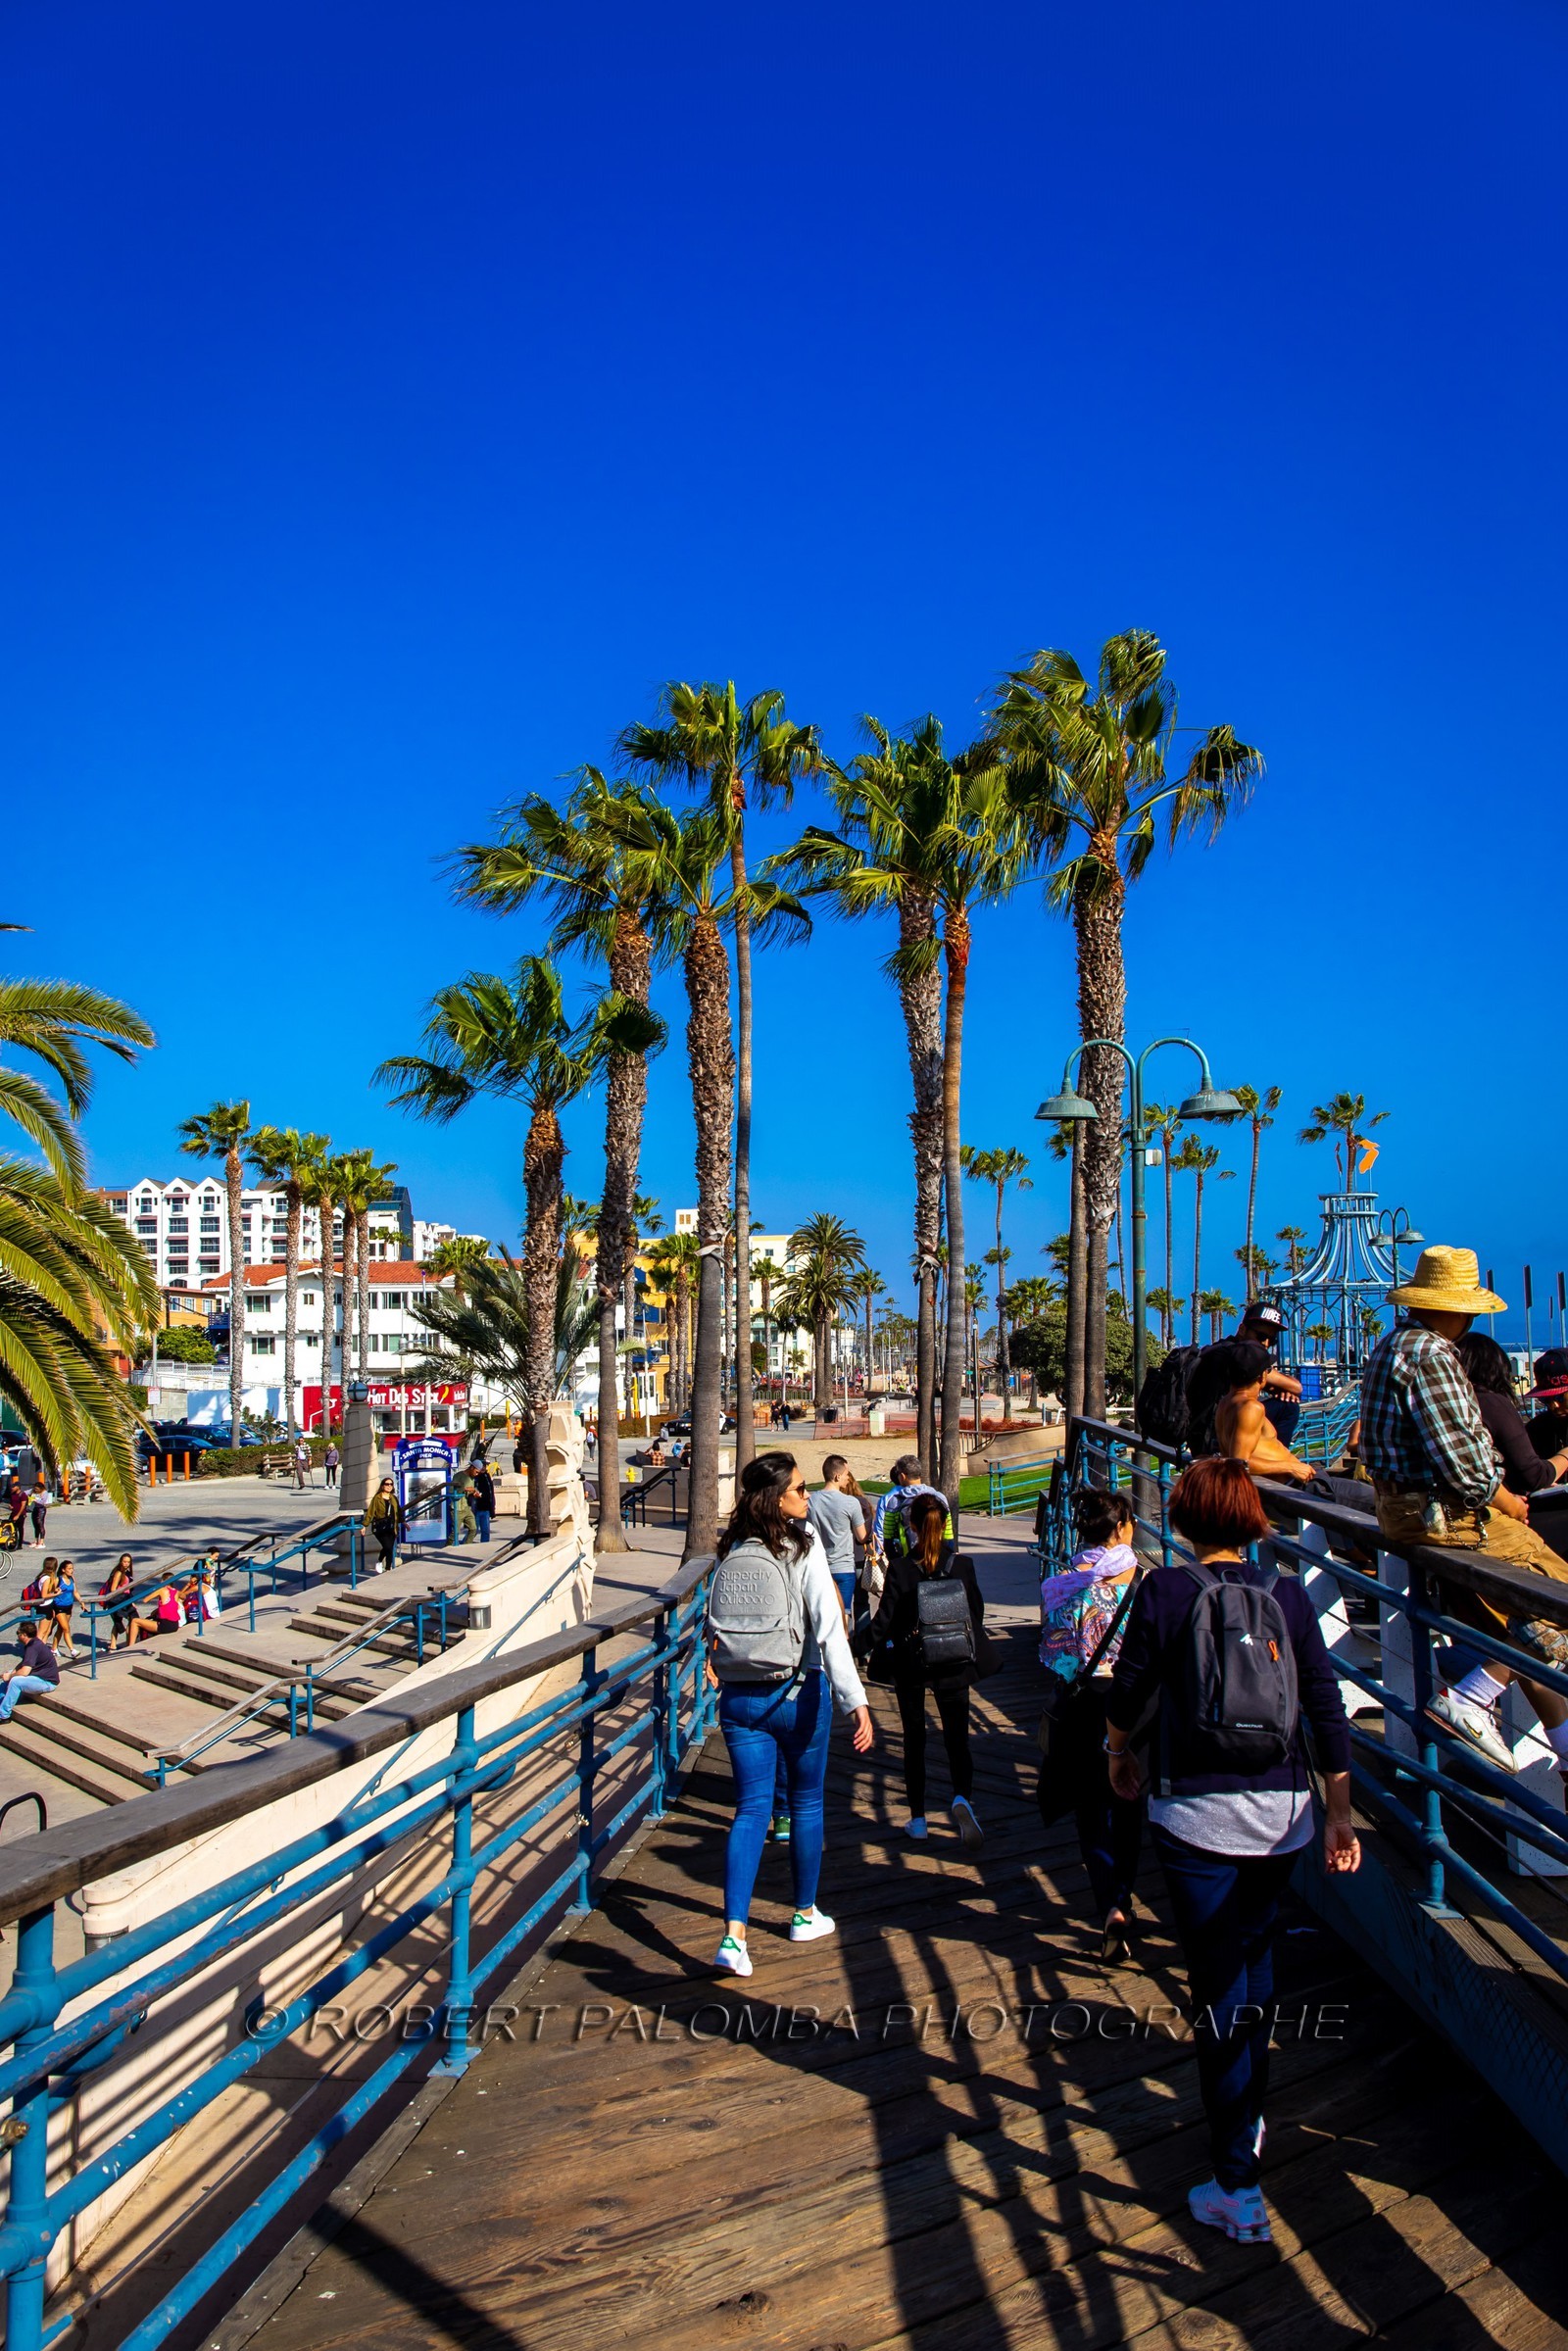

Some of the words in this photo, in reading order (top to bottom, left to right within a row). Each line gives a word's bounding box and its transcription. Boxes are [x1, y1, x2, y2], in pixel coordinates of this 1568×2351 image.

[402, 1448, 421, 1459] SANTA
[423, 1446, 449, 1457] MONICA
[720, 1569, 772, 1583] Superdry
[719, 1581, 758, 1594] Japan
